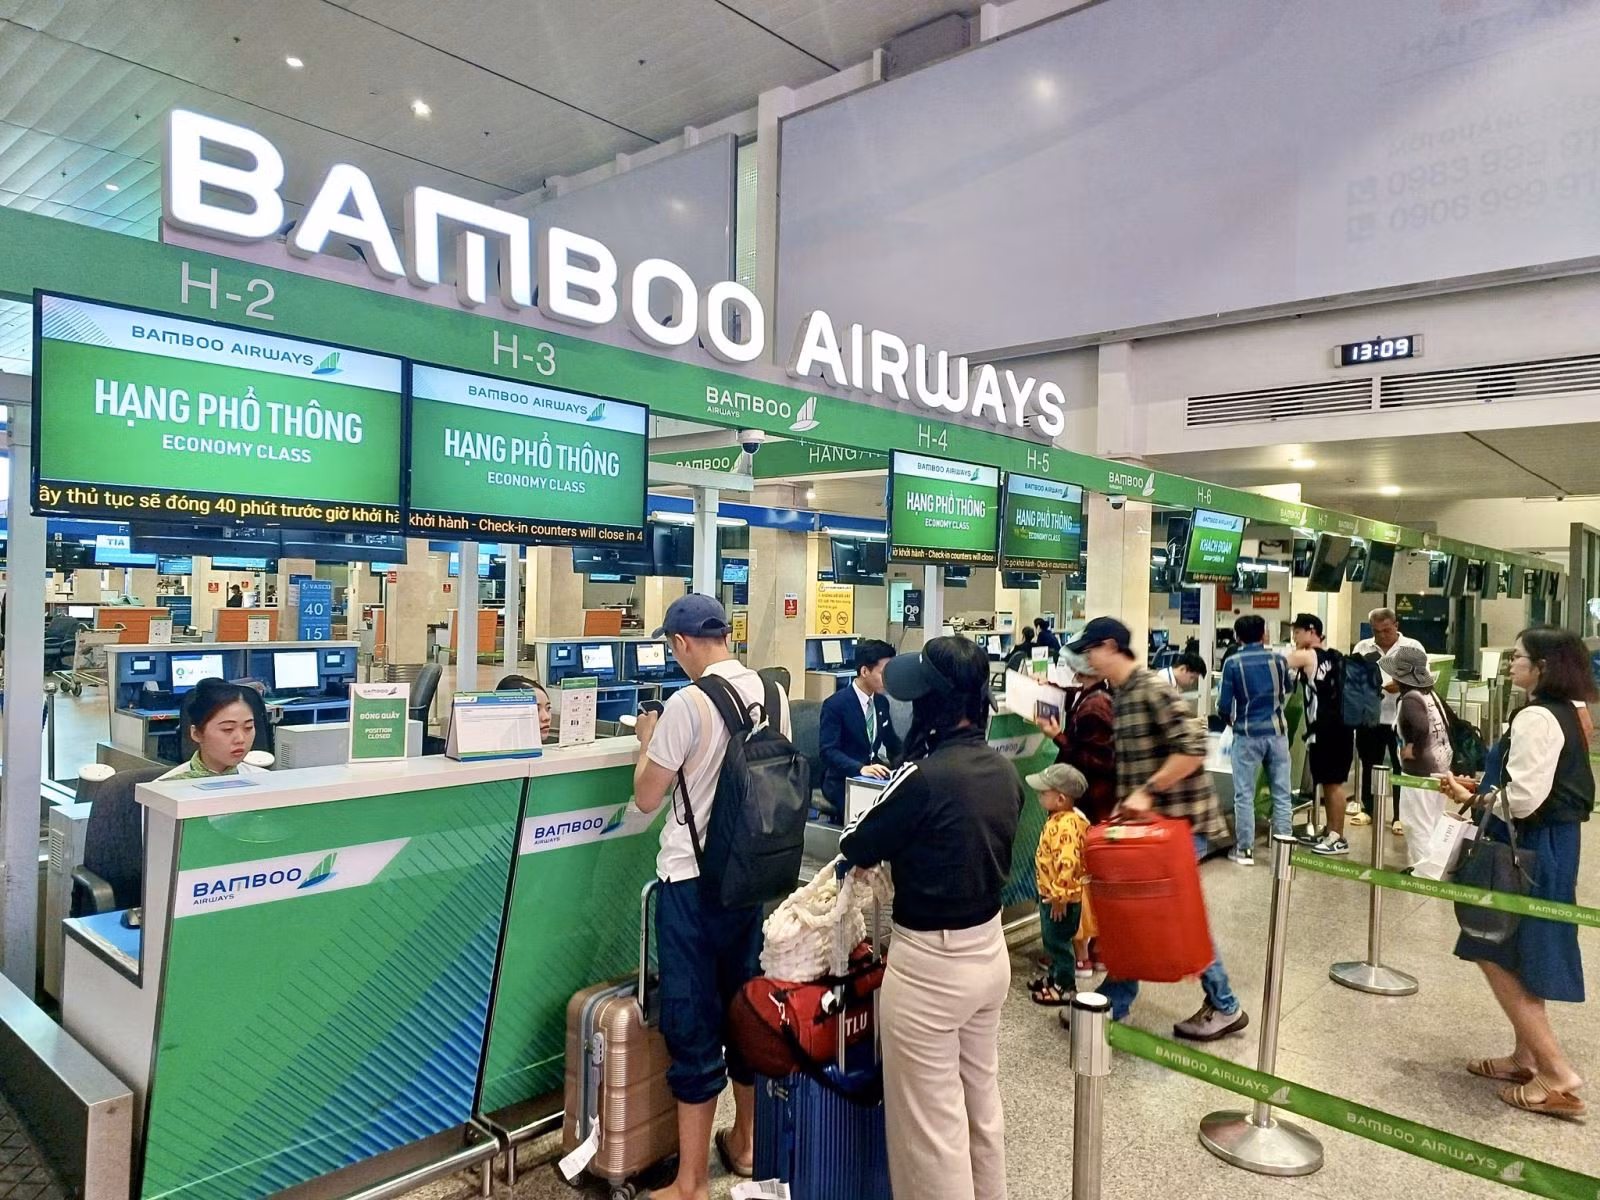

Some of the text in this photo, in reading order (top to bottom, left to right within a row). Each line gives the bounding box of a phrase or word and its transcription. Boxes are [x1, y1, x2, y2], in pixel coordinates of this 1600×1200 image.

[168, 109, 1066, 438] BAMBOO AIRWAYS
[180, 261, 275, 321] H-2
[131, 325, 314, 367] BAMBOO AIRWAYS
[493, 330, 557, 376] H-3
[1352, 338, 1409, 361] 13:09
[95, 378, 363, 445] HẠNG PHỔ THÔNG
[468, 384, 588, 416] BAMBOO AIRWAYS
[706, 385, 791, 419] BAMBOO
[707, 406, 741, 419] AIRWAYS
[162, 433, 312, 464] ECONOMY CLASS
[918, 423, 948, 452] H-4
[444, 427, 620, 478] HẠNG PHỔ THÔNG
[1026, 448, 1050, 473] H-5
[917, 462, 972, 477] BAMBOO AIRWAYS
[1108, 471, 1144, 488] BAMBOO
[487, 471, 586, 494] ECONOMY CLASS
[66, 486, 99, 505] thủ
[104, 491, 134, 509] tục
[139, 492, 161, 508] sẽ
[165, 494, 211, 514] đóng
[214, 498, 236, 513] 40
[240, 500, 277, 518] phút
[280, 503, 322, 519] trước
[326, 504, 350, 522] giờ
[352, 506, 383, 523] khởi
[906, 489, 986, 518] HẠNG PHỔ THÔNG
[1197, 486, 1212, 505] H-6
[409, 512, 435, 527] khởi
[438, 514, 469, 530] hành
[479, 518, 528, 534] Check-in
[530, 522, 577, 538] counters
[579, 523, 597, 539] will
[599, 525, 624, 540] close
[626, 528, 636, 540] in
[637, 529, 644, 541] 4
[925, 517, 970, 531] ECONOMY CLASS
[1016, 508, 1036, 529] HẠNG
[928, 550, 951, 561] Check-in
[951, 552, 972, 562] counters
[304, 602, 324, 615] 40
[305, 627, 323, 640] 15
[534, 817, 603, 839] BAMBOO
[534, 836, 561, 845] AIRWAYS
[1291, 855, 1360, 876] BAMBOO AIRWAYS
[193, 867, 303, 898] BAMBOO
[1401, 880, 1480, 901] BAMBOO AIRWAYS
[193, 893, 235, 905] AIRWAYS
[1528, 903, 1573, 918] BAMBOO
[1155, 1046, 1270, 1094] BAMBOO AIRWAYS
[1346, 1112, 1498, 1169] BAMBOO AIRWAYS
